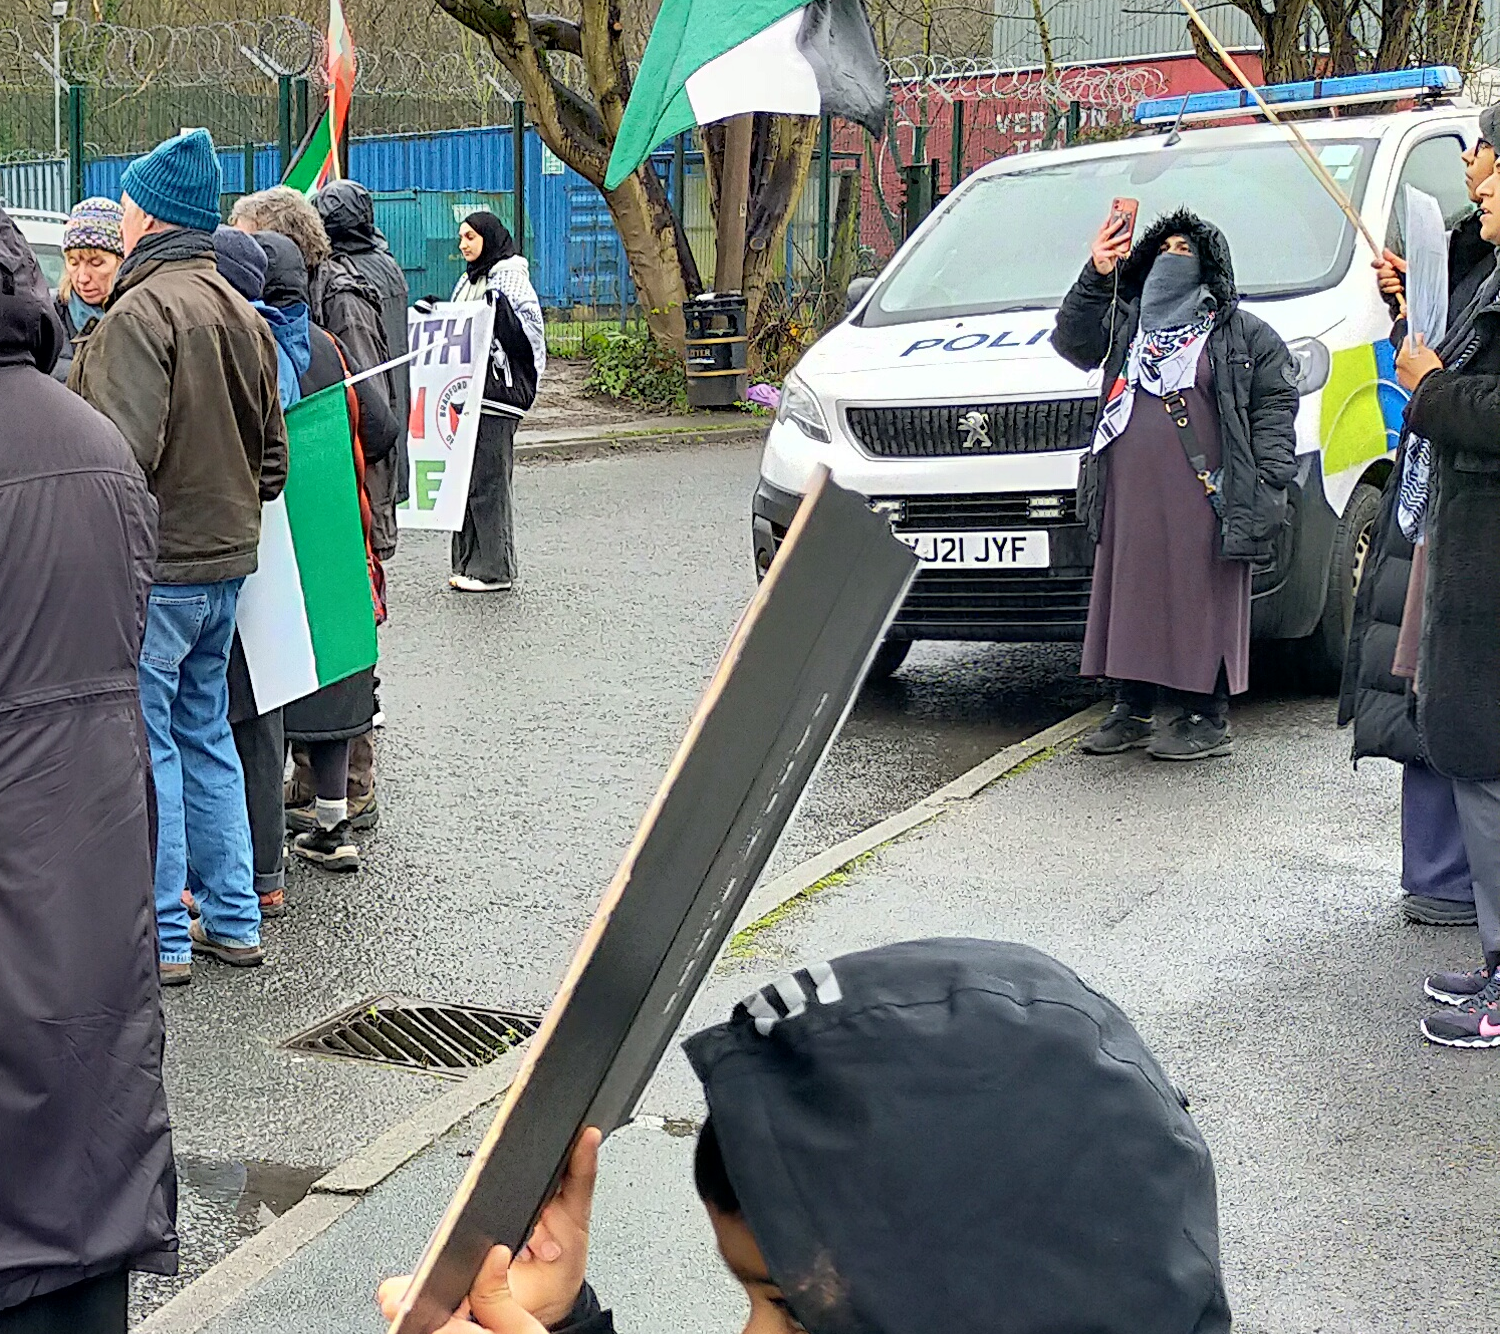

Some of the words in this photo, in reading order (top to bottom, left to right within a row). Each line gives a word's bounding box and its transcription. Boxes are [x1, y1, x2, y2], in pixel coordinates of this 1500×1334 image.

[408, 317, 473, 367] ITH
[899, 328, 1050, 358] POLI
[439, 380, 468, 418] BRADFORD
[974, 536, 1027, 563] JYF
